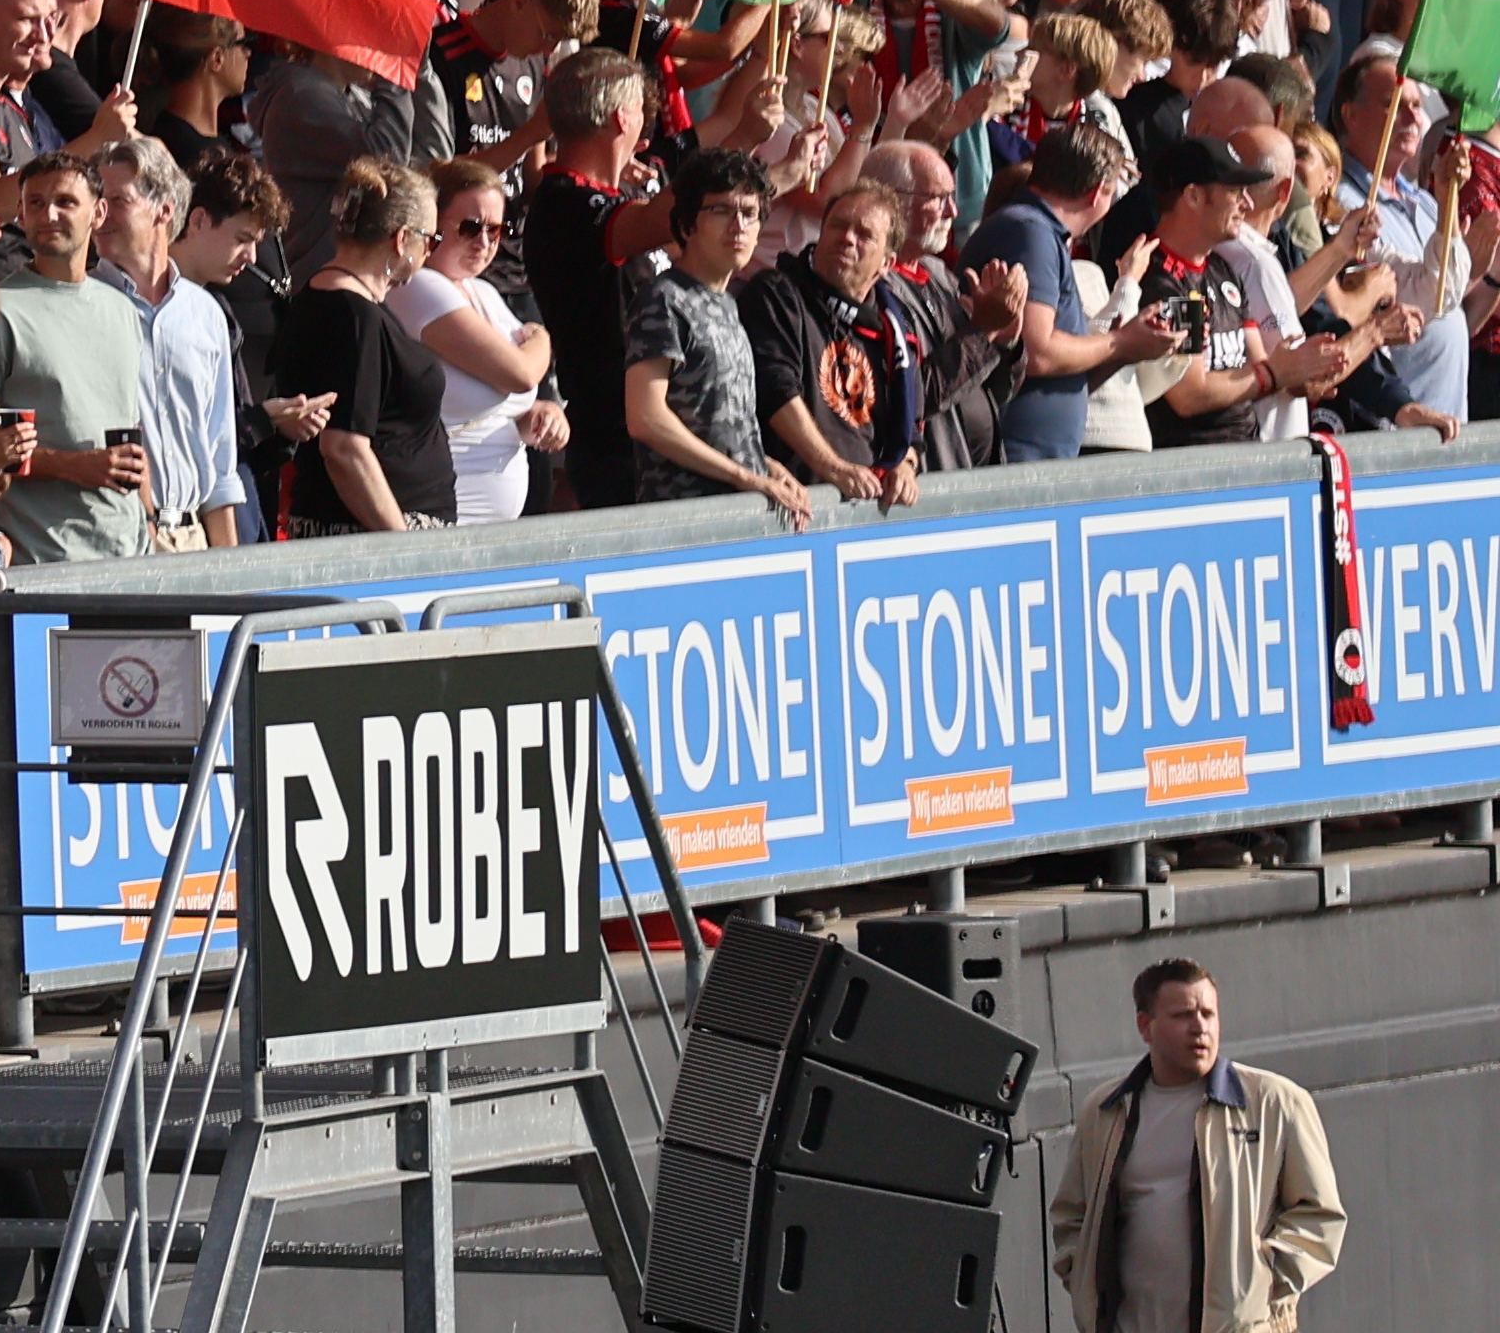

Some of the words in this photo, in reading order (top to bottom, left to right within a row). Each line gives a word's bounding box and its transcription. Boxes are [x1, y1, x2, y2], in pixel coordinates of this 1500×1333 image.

[854, 581, 1051, 767] STONE
[1097, 555, 1285, 735] STONE
[81, 719, 133, 731] VERBODEN
[606, 612, 807, 803] STONE
[912, 793, 932, 826] Wij
[932, 789, 963, 818] maken
[964, 780, 1007, 813] vrienden
[1151, 766, 1168, 795] Wij
[1168, 762, 1199, 787] maken
[1200, 753, 1241, 783] vrienden
[361, 698, 591, 976] ROBEY
[684, 825, 716, 852] maken
[717, 819, 762, 849] vrienden
